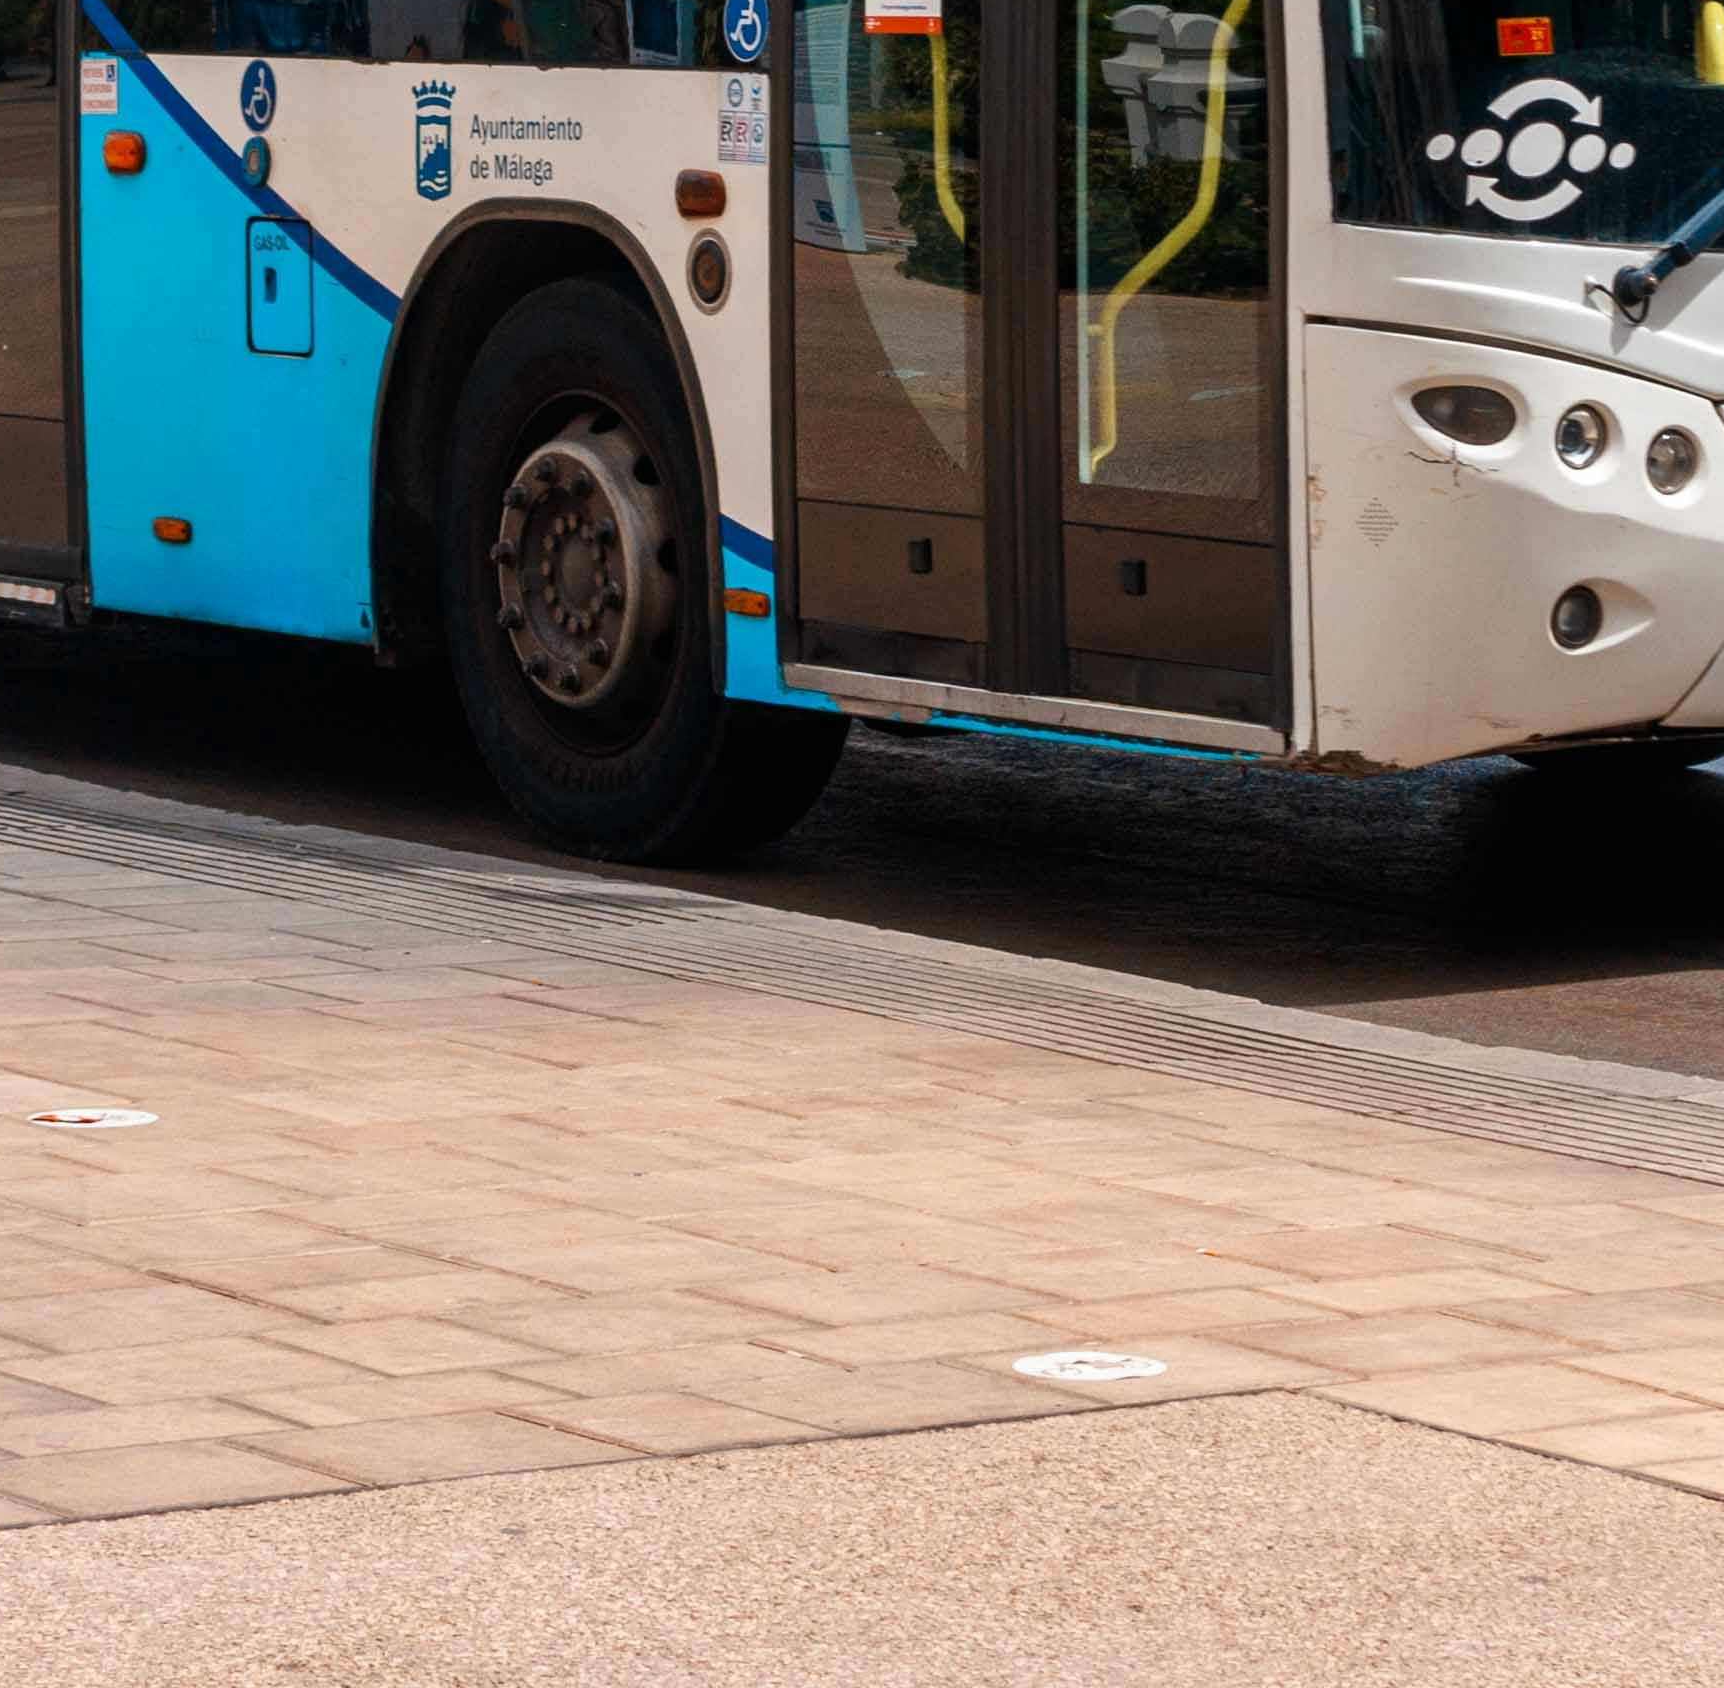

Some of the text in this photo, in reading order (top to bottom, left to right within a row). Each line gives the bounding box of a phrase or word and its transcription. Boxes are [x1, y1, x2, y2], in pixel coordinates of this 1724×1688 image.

[469, 113, 583, 145] Ayuntamiento
[469, 153, 554, 187] de Málaga
